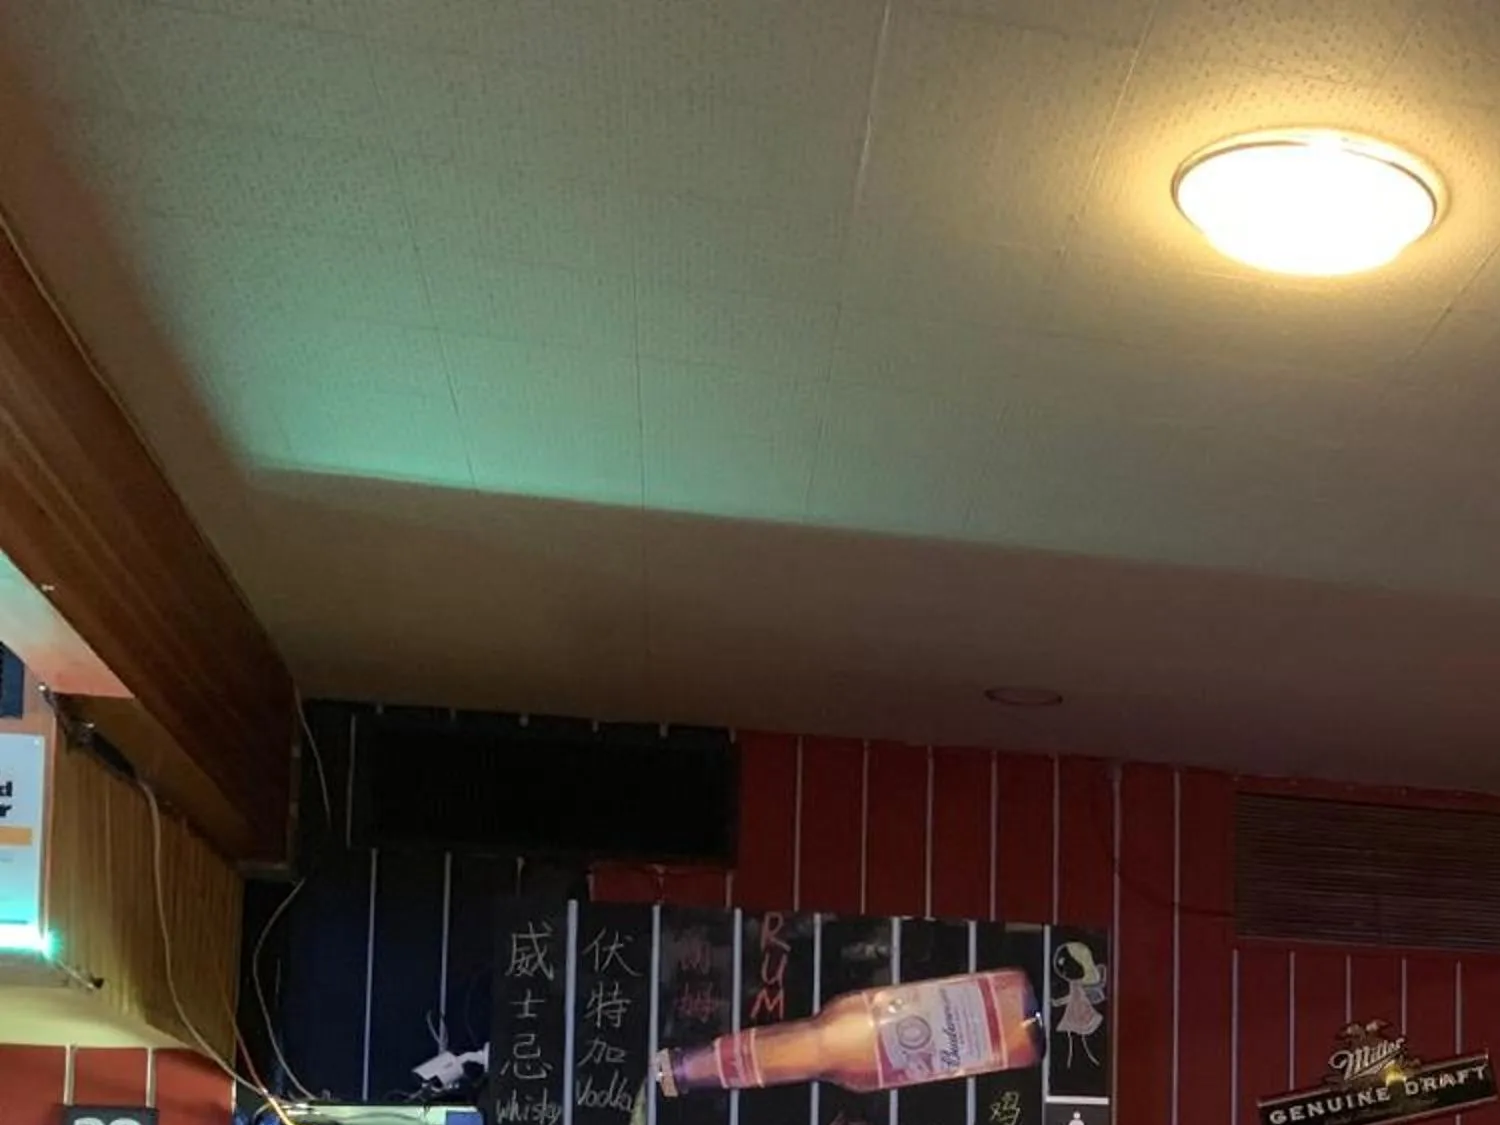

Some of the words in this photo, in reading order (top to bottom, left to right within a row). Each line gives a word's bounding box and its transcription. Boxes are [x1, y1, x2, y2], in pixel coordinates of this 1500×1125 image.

[500, 920, 554, 1080] 威士忌
[578, 928, 643, 1068] 伏特加
[751, 912, 791, 1018] RUM
[1269, 1086, 1391, 1125] GENUINE
[1404, 1064, 1489, 1096] DRAFT
